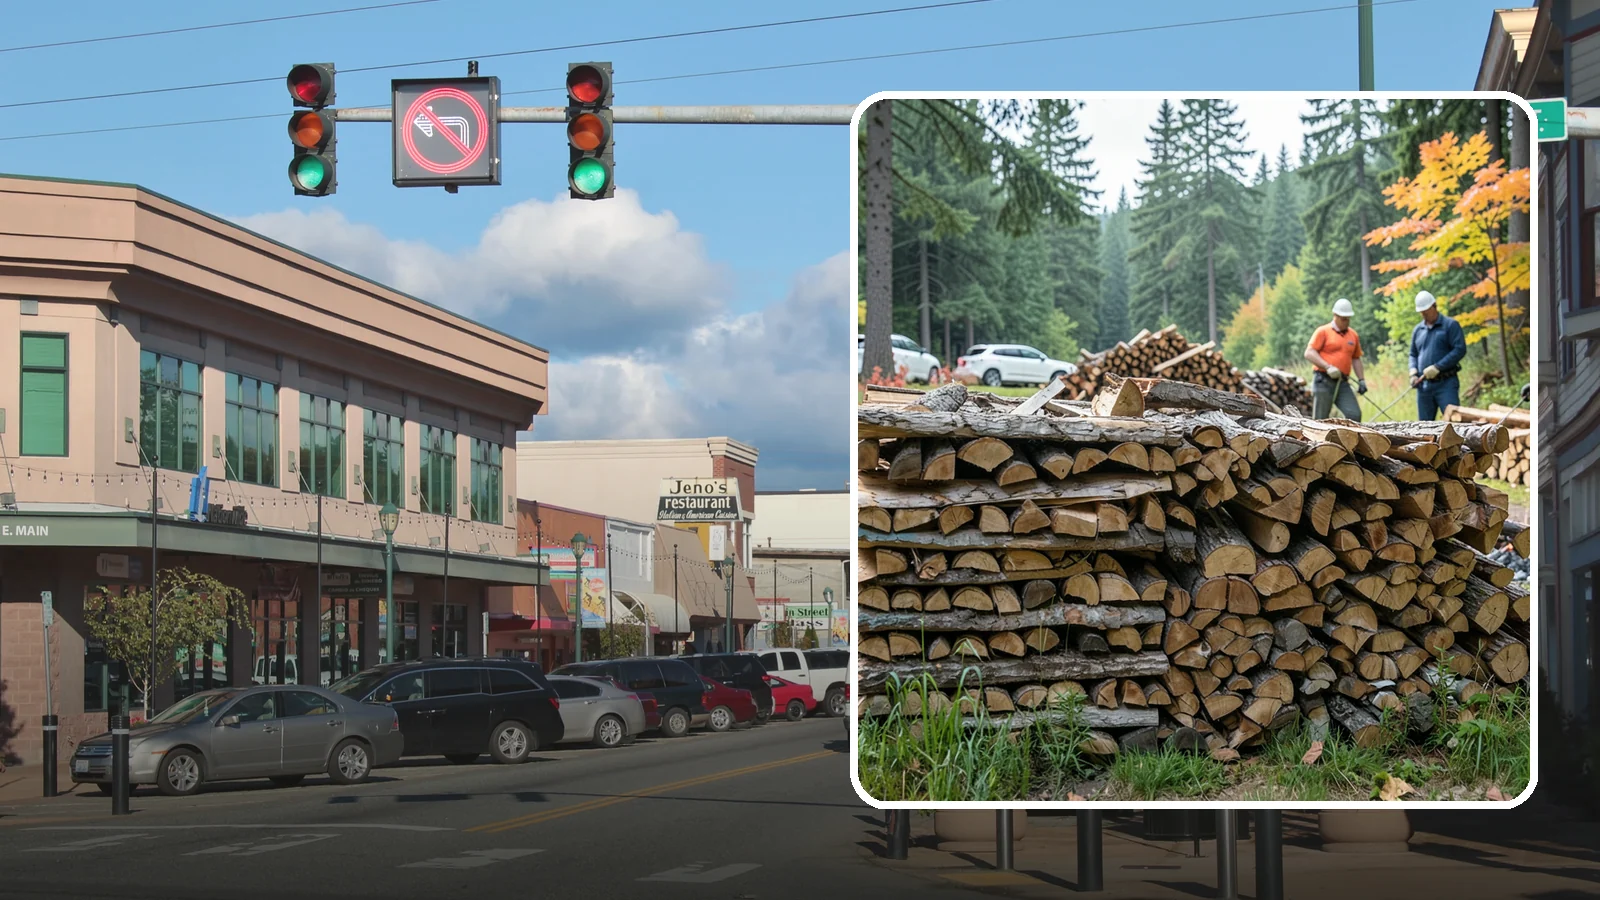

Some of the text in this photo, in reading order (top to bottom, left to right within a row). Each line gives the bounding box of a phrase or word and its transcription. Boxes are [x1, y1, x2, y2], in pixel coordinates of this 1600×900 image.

[669, 480, 728, 495] Jeno's
[665, 496, 731, 509] restaurant
[659, 509, 682, 520] Italian
[686, 509, 715, 520] American
[715, 509, 738, 519] Cuisine
[2, 525, 49, 536] E. MAIN
[797, 607, 828, 617] Street
